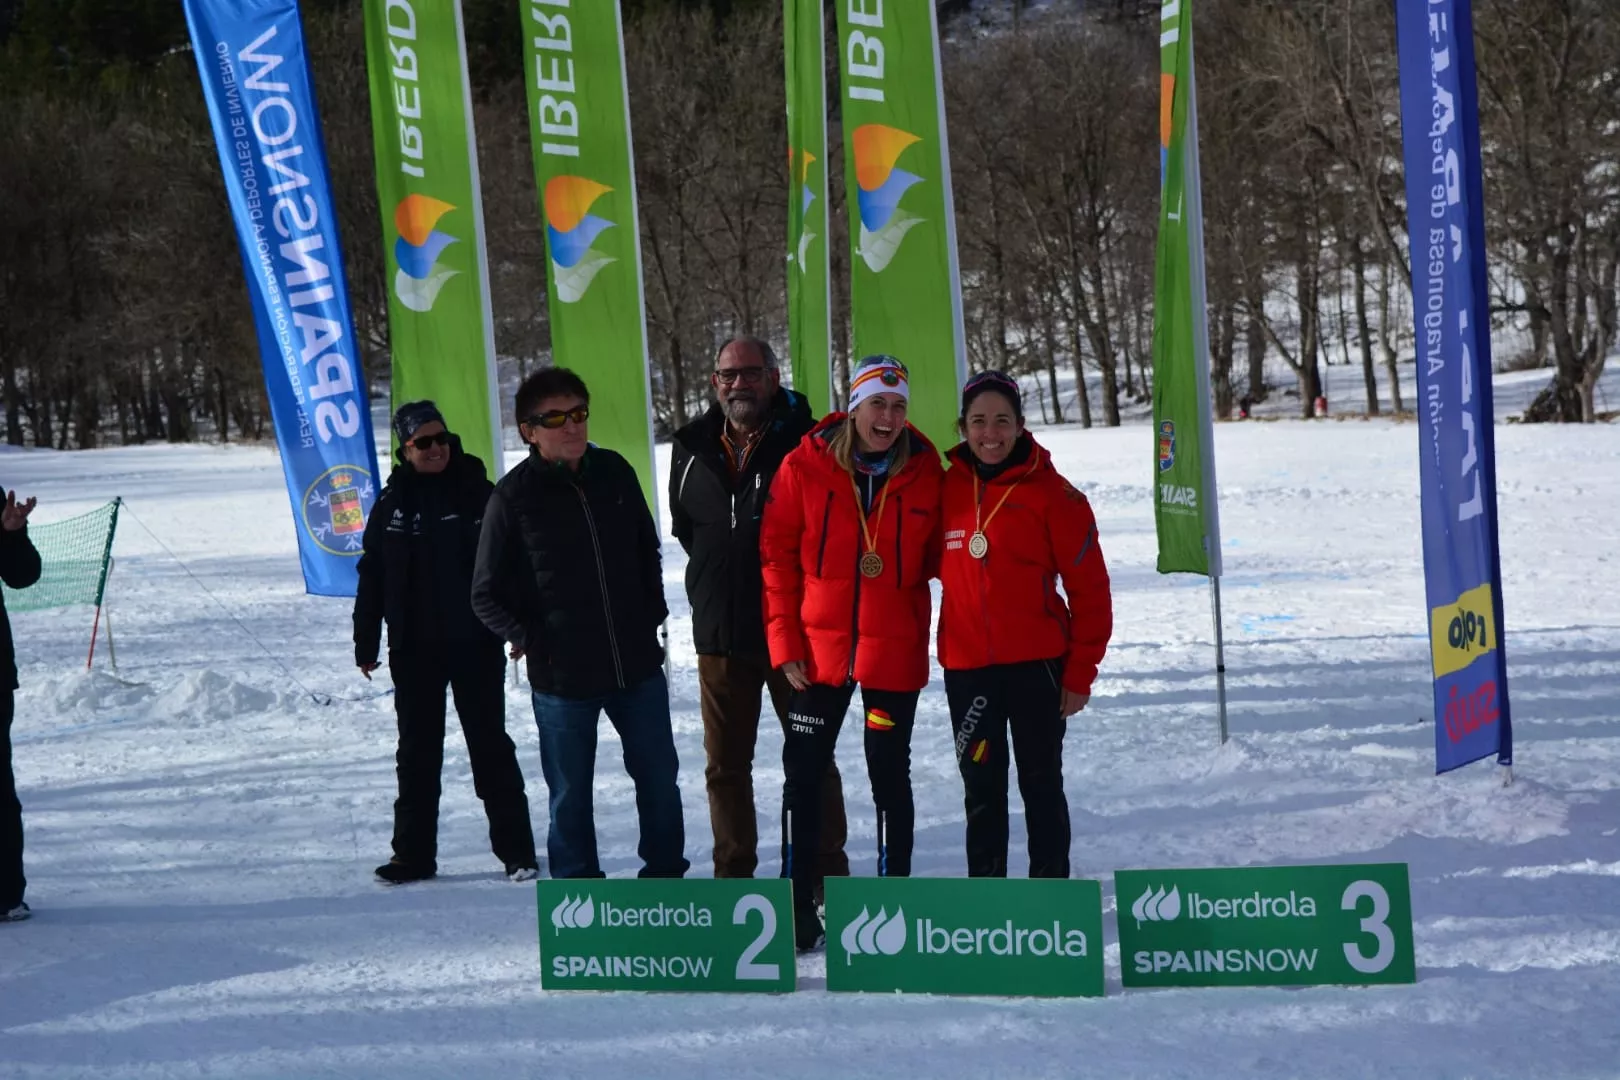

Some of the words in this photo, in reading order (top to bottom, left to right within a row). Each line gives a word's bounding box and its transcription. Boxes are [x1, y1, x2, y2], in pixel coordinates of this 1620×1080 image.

[792, 723, 815, 734] CIVIL
[601, 902, 712, 927] Iberdrola
[1187, 890, 1317, 919] Iberdrola
[733, 893, 781, 980] 2
[916, 918, 1088, 957] Iberdrola
[1340, 880, 1395, 974] 3
[552, 955, 713, 978] SPAINSNOW
[1134, 948, 1319, 974] SPAINSNOW
